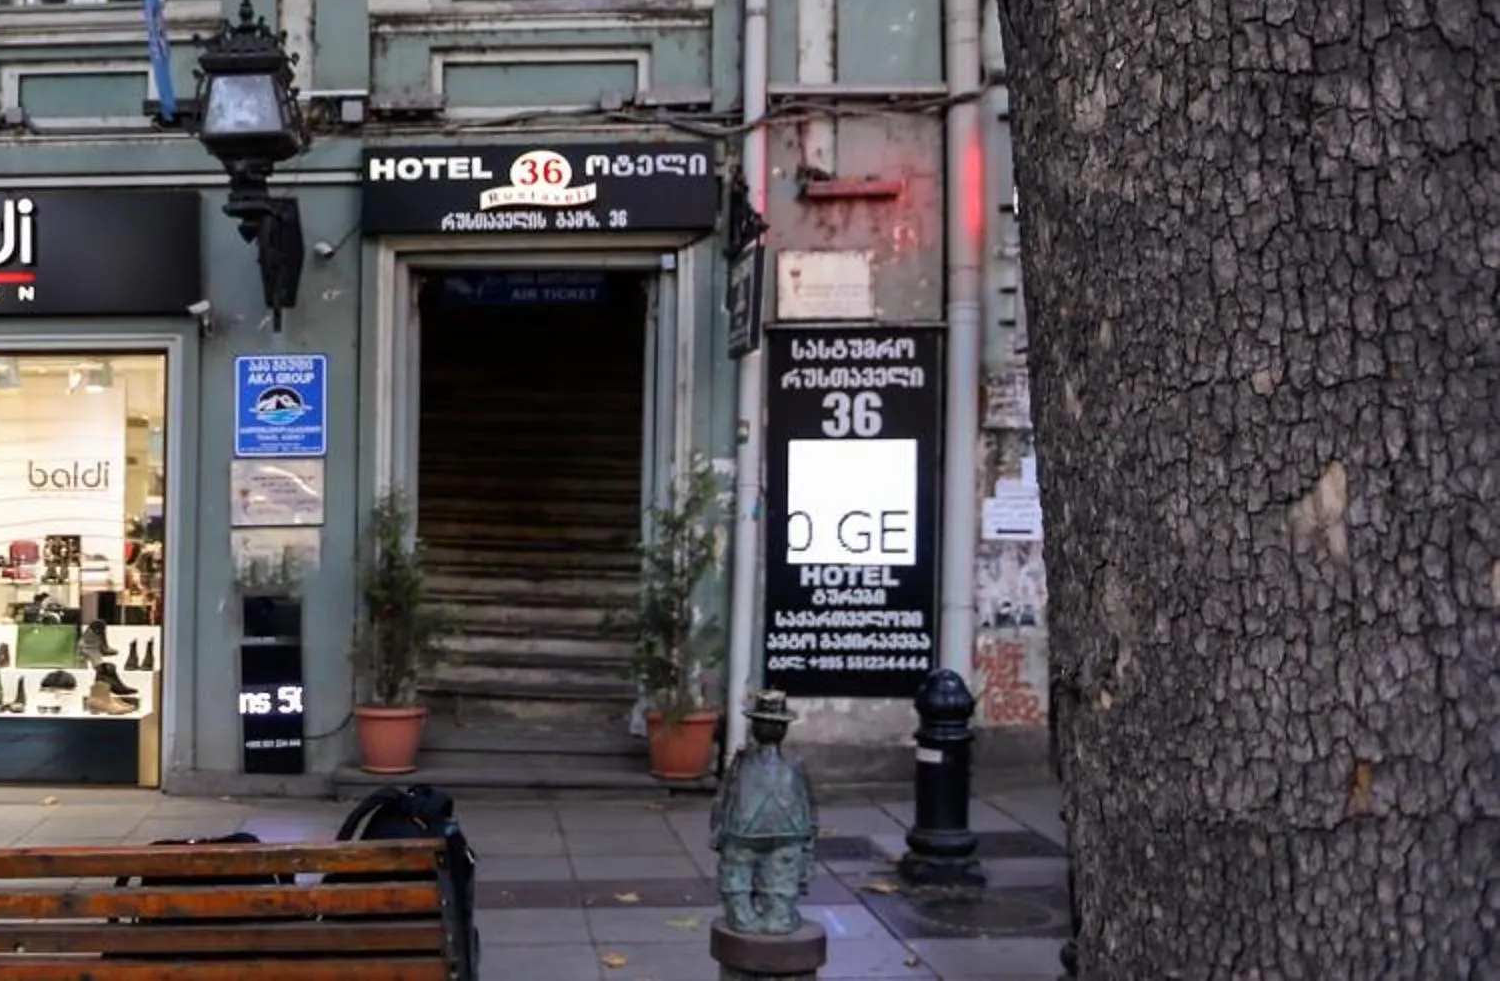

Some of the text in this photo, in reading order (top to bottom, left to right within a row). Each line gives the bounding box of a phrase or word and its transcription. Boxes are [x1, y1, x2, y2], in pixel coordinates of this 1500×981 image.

[369, 154, 707, 186] HOTEL 36 ოტელი
[441, 210, 547, 231] რუსთაველის
[609, 208, 627, 228] 36
[791, 338, 916, 360] სასტუმრო
[781, 367, 925, 389] რუსთაველი
[821, 390, 884, 438] 36
[28, 460, 111, 488] baldi
[837, 510, 909, 553] GE
[800, 565, 901, 587] HOTEL
[766, 632, 817, 650] ავტო
